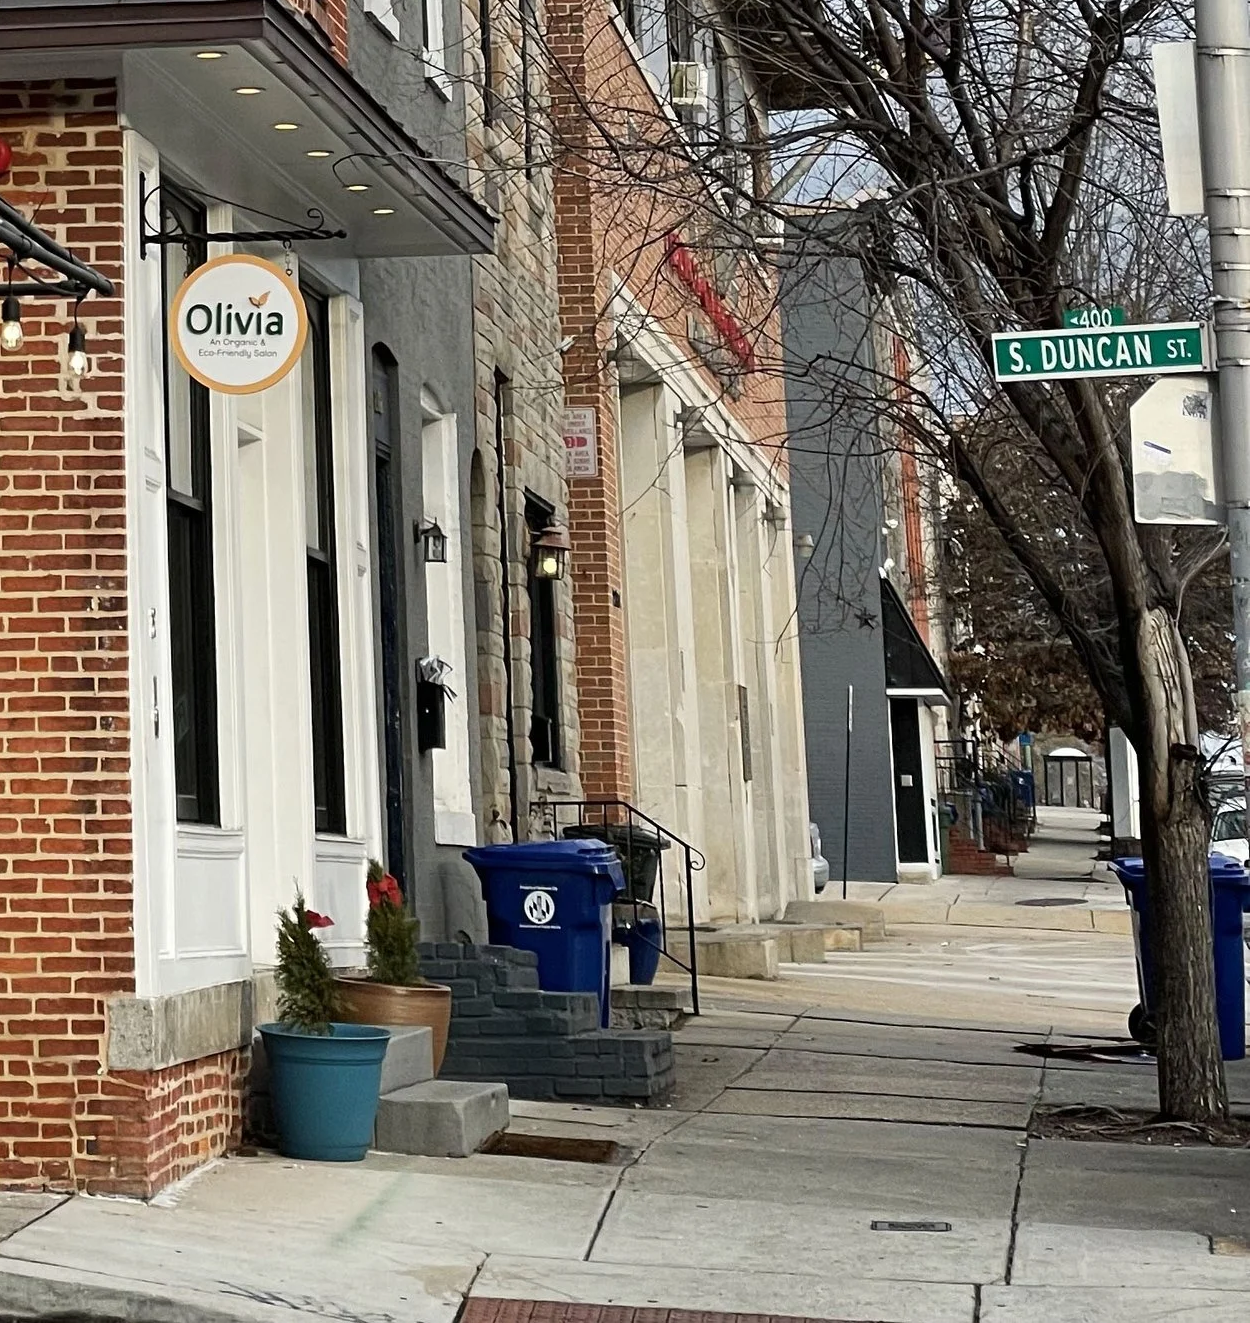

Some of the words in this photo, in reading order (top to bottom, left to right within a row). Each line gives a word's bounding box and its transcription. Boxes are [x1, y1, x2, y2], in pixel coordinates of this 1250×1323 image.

[185, 302, 284, 336] Olivia
[198, 348, 252, 359] Eco-Friendly
[253, 349, 278, 358] Salon
[209, 338, 221, 346] An
[223, 338, 258, 348] Organic
[260, 338, 266, 347] &
[1009, 341, 1032, 373] S.
[1040, 334, 1153, 371] DUNCAN
[1166, 339, 1193, 359] ST.
